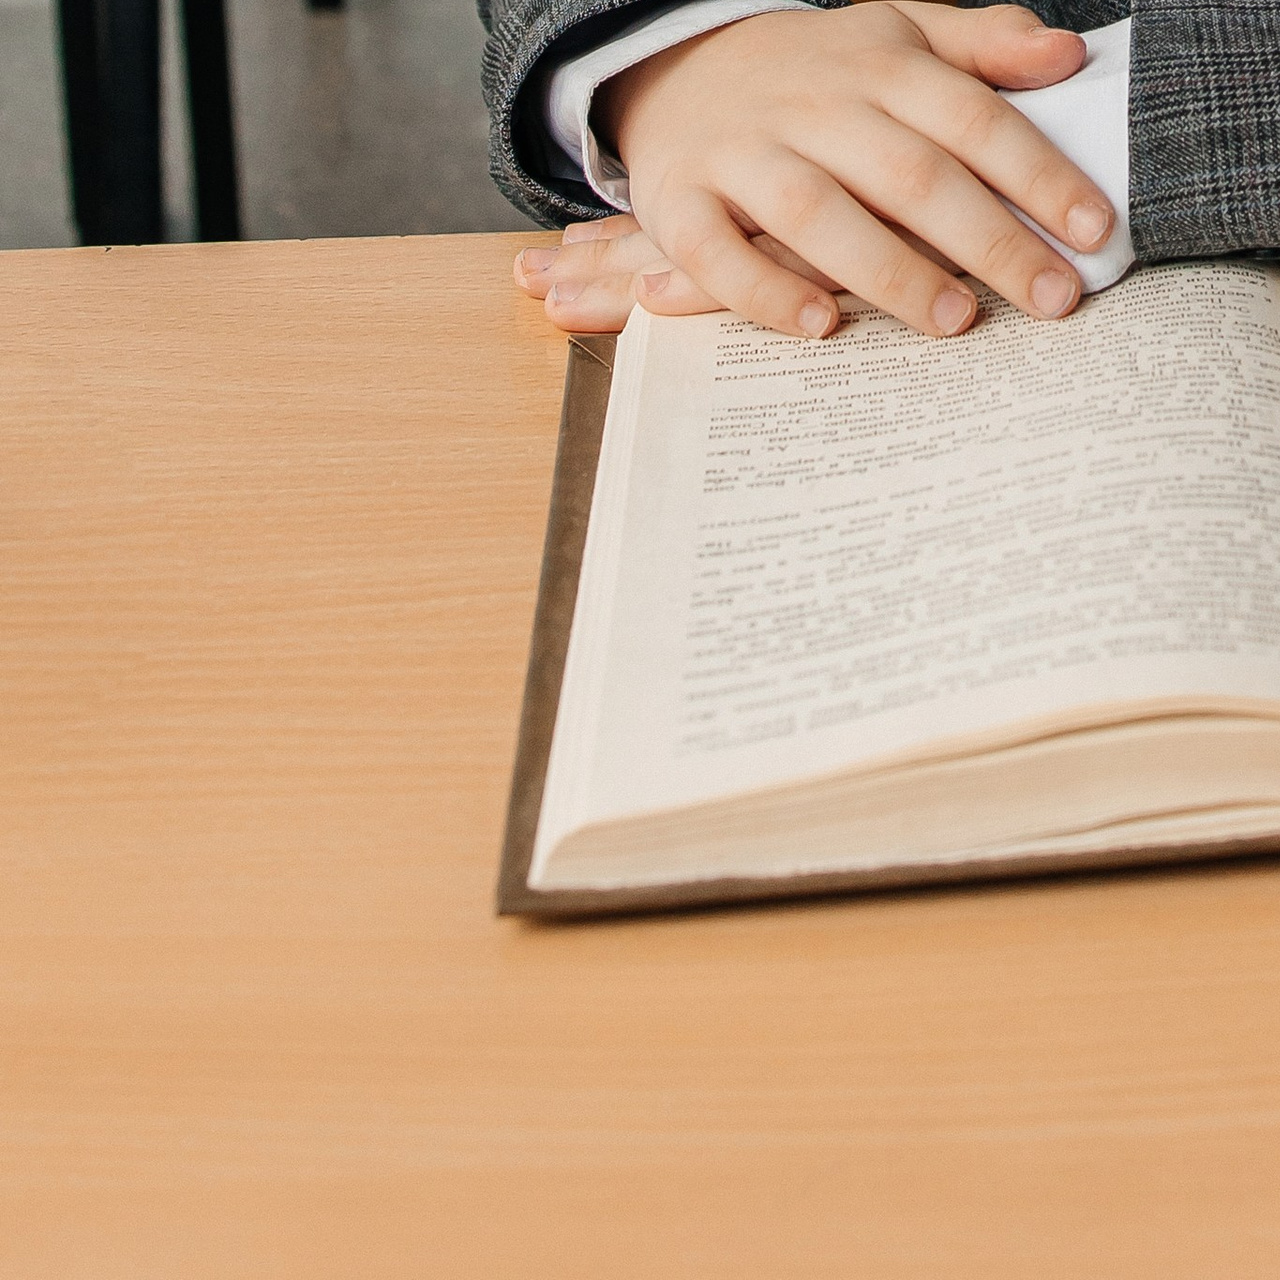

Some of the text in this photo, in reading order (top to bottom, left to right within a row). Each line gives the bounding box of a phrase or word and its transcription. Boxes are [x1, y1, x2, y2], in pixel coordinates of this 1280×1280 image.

[1200, 304, 1250, 314] Опять
[1066, 319, 1086, 329] по
[1092, 306, 1190, 329] послышался
[986, 326, 1058, 346] которому
[1044, 327, 1082, 340] голос
[918, 344, 974, 358] Элоиза
[860, 355, 906, 367] Тизон
[714, 362, 850, 381] приговаривается
[798, 357, 940, 382] выкрикивающий:
